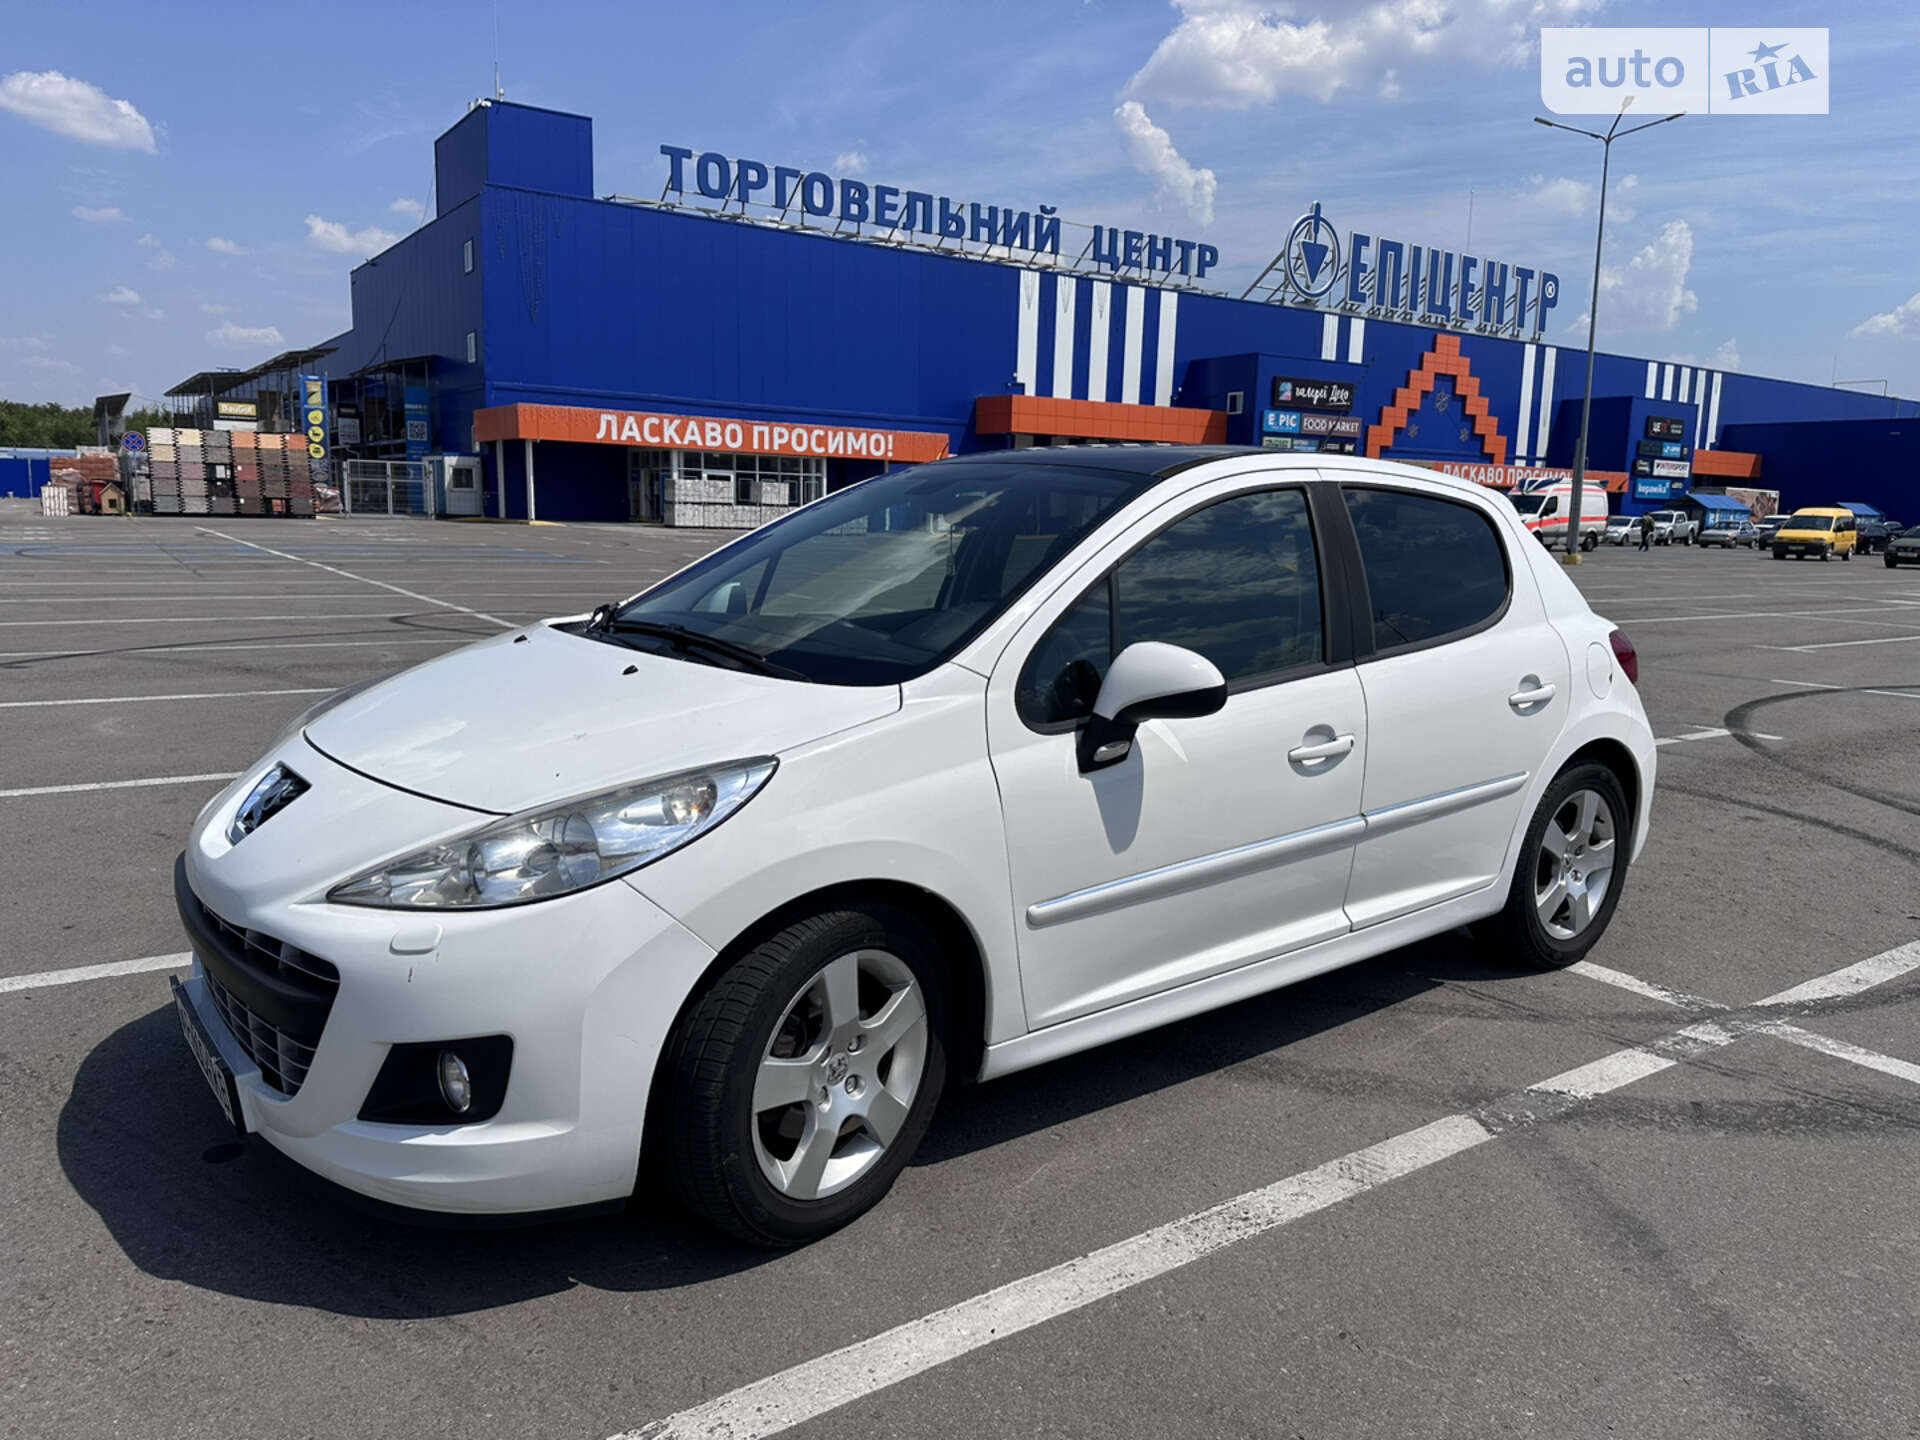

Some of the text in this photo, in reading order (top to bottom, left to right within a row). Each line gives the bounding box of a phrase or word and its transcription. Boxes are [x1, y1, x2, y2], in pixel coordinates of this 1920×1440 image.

[660, 144, 1220, 279] ТОРГОВЕЛЬНИЙ ЦЕНТР
[1347, 230, 1560, 333] ЕПІЦЕНТР
[596, 414, 894, 457] ЛАСКАВО ПРОСИМО!
[1303, 418, 1360, 433] FOOD MARKET
